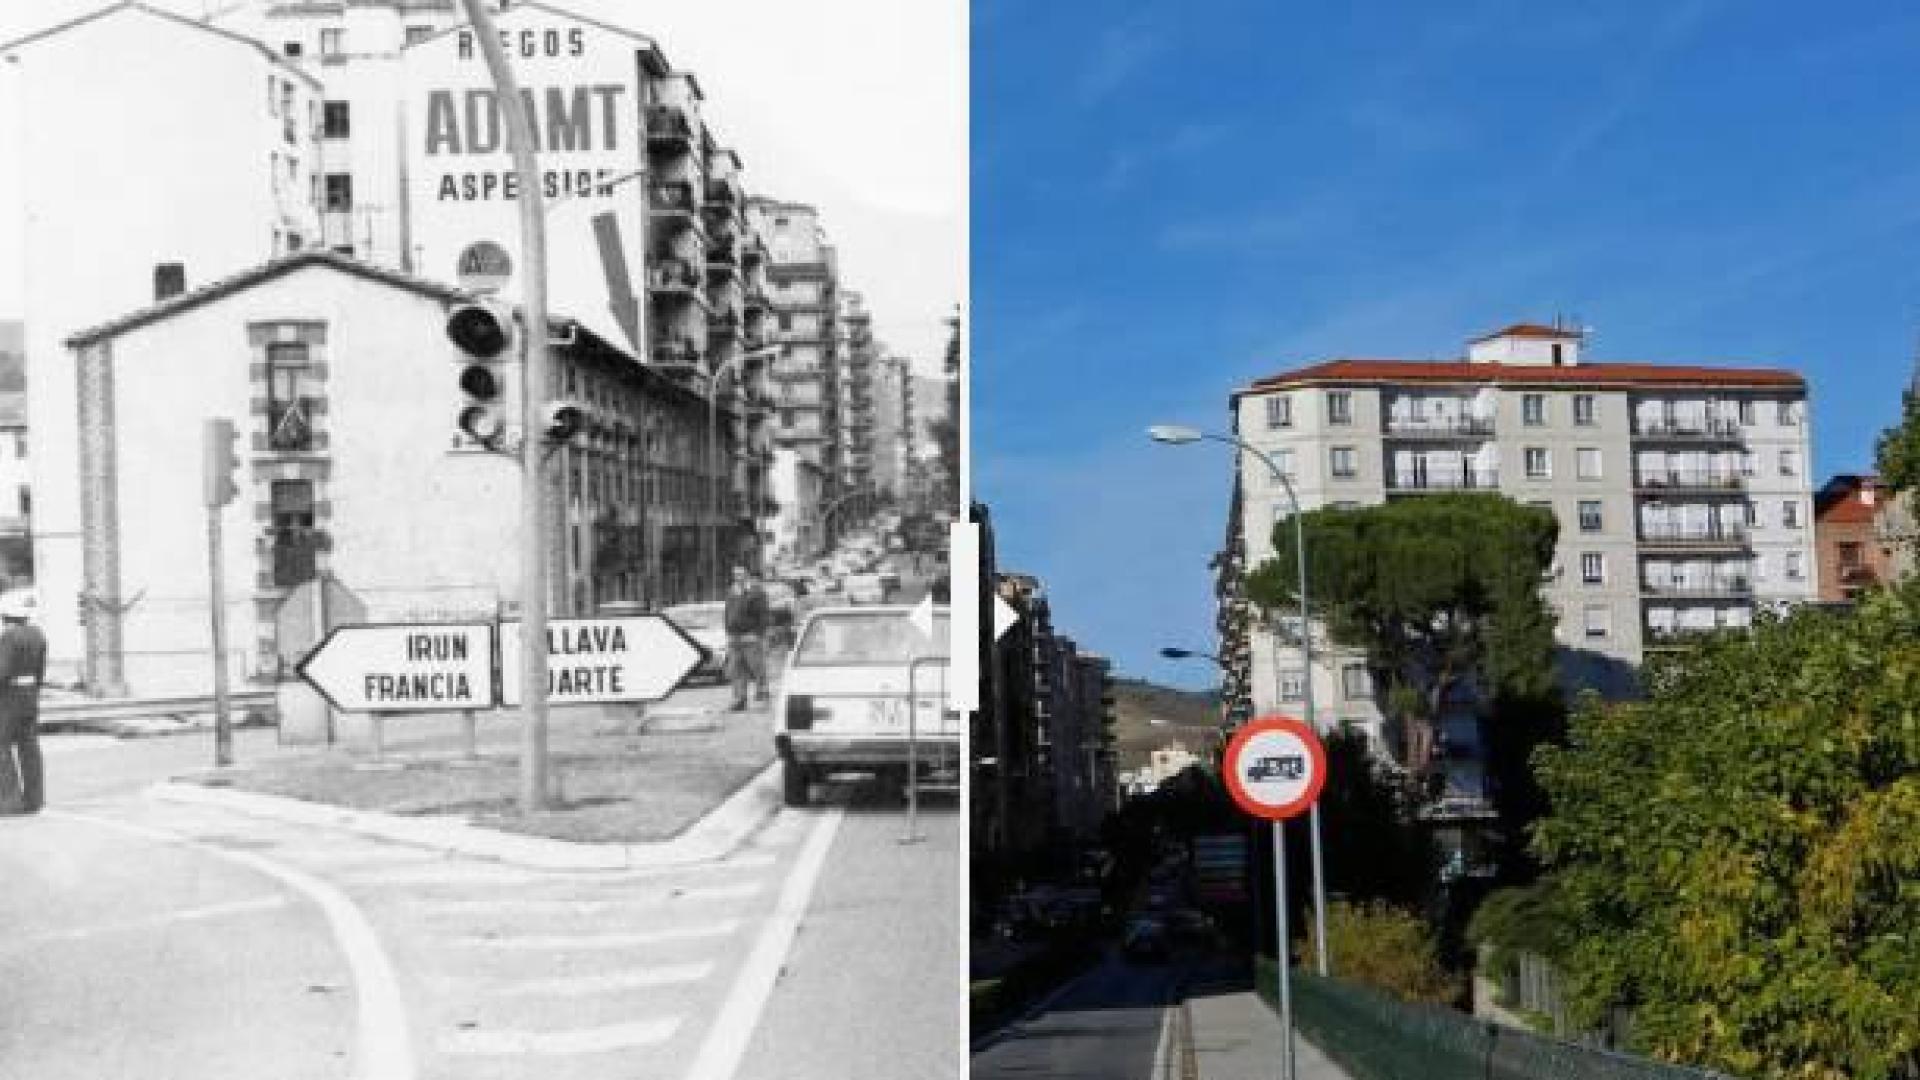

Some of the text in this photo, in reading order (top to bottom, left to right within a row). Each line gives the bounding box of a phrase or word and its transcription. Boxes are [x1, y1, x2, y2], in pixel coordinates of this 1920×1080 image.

[458, 29, 584, 59] REGOS
[438, 170, 613, 200] ASPESION
[407, 633, 467, 661] IRUN
[364, 673, 471, 701] FRANCIA
